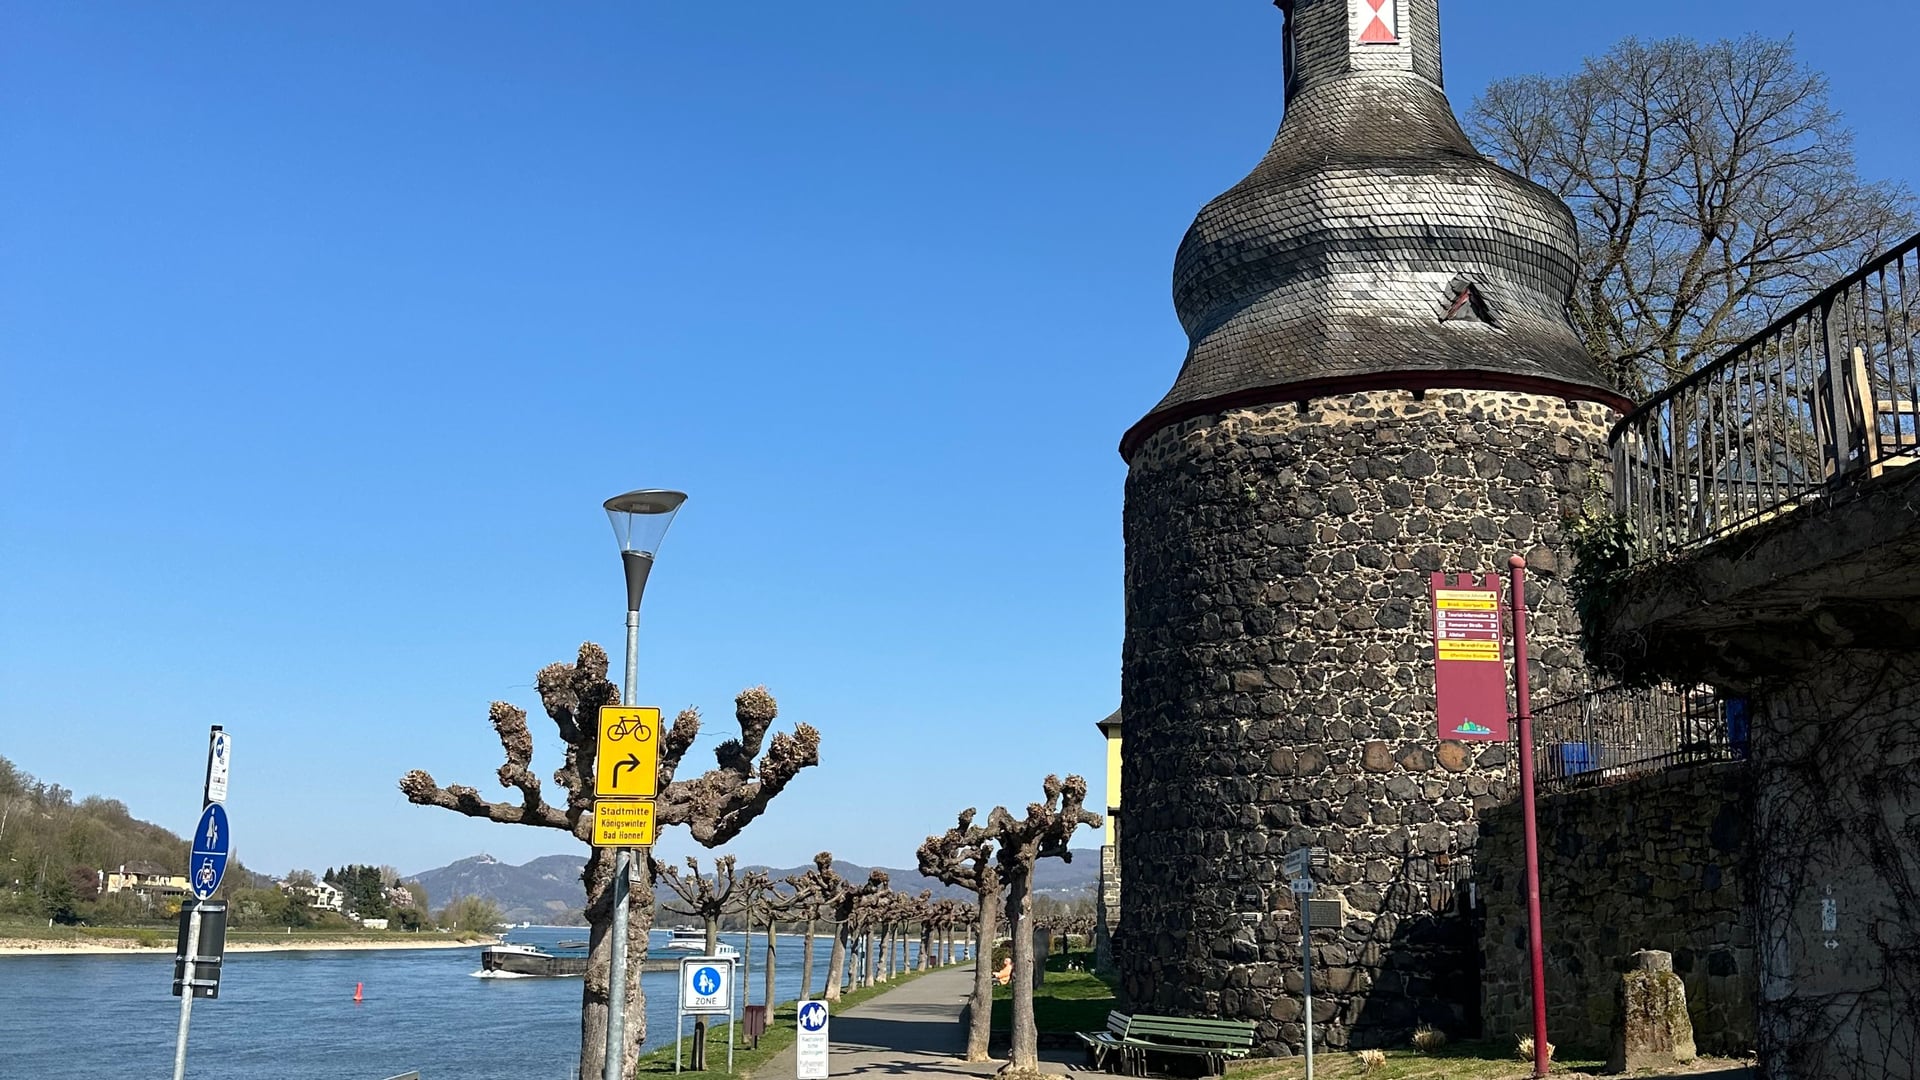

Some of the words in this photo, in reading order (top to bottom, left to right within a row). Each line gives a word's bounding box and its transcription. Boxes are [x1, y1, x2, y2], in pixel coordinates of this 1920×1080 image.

[600, 806, 650, 816] Stadtmitte
[601, 819, 647, 829] Königswinter
[603, 830, 616, 839] Bad
[619, 831, 644, 840] Honnef
[695, 997, 717, 1005] ZONE
